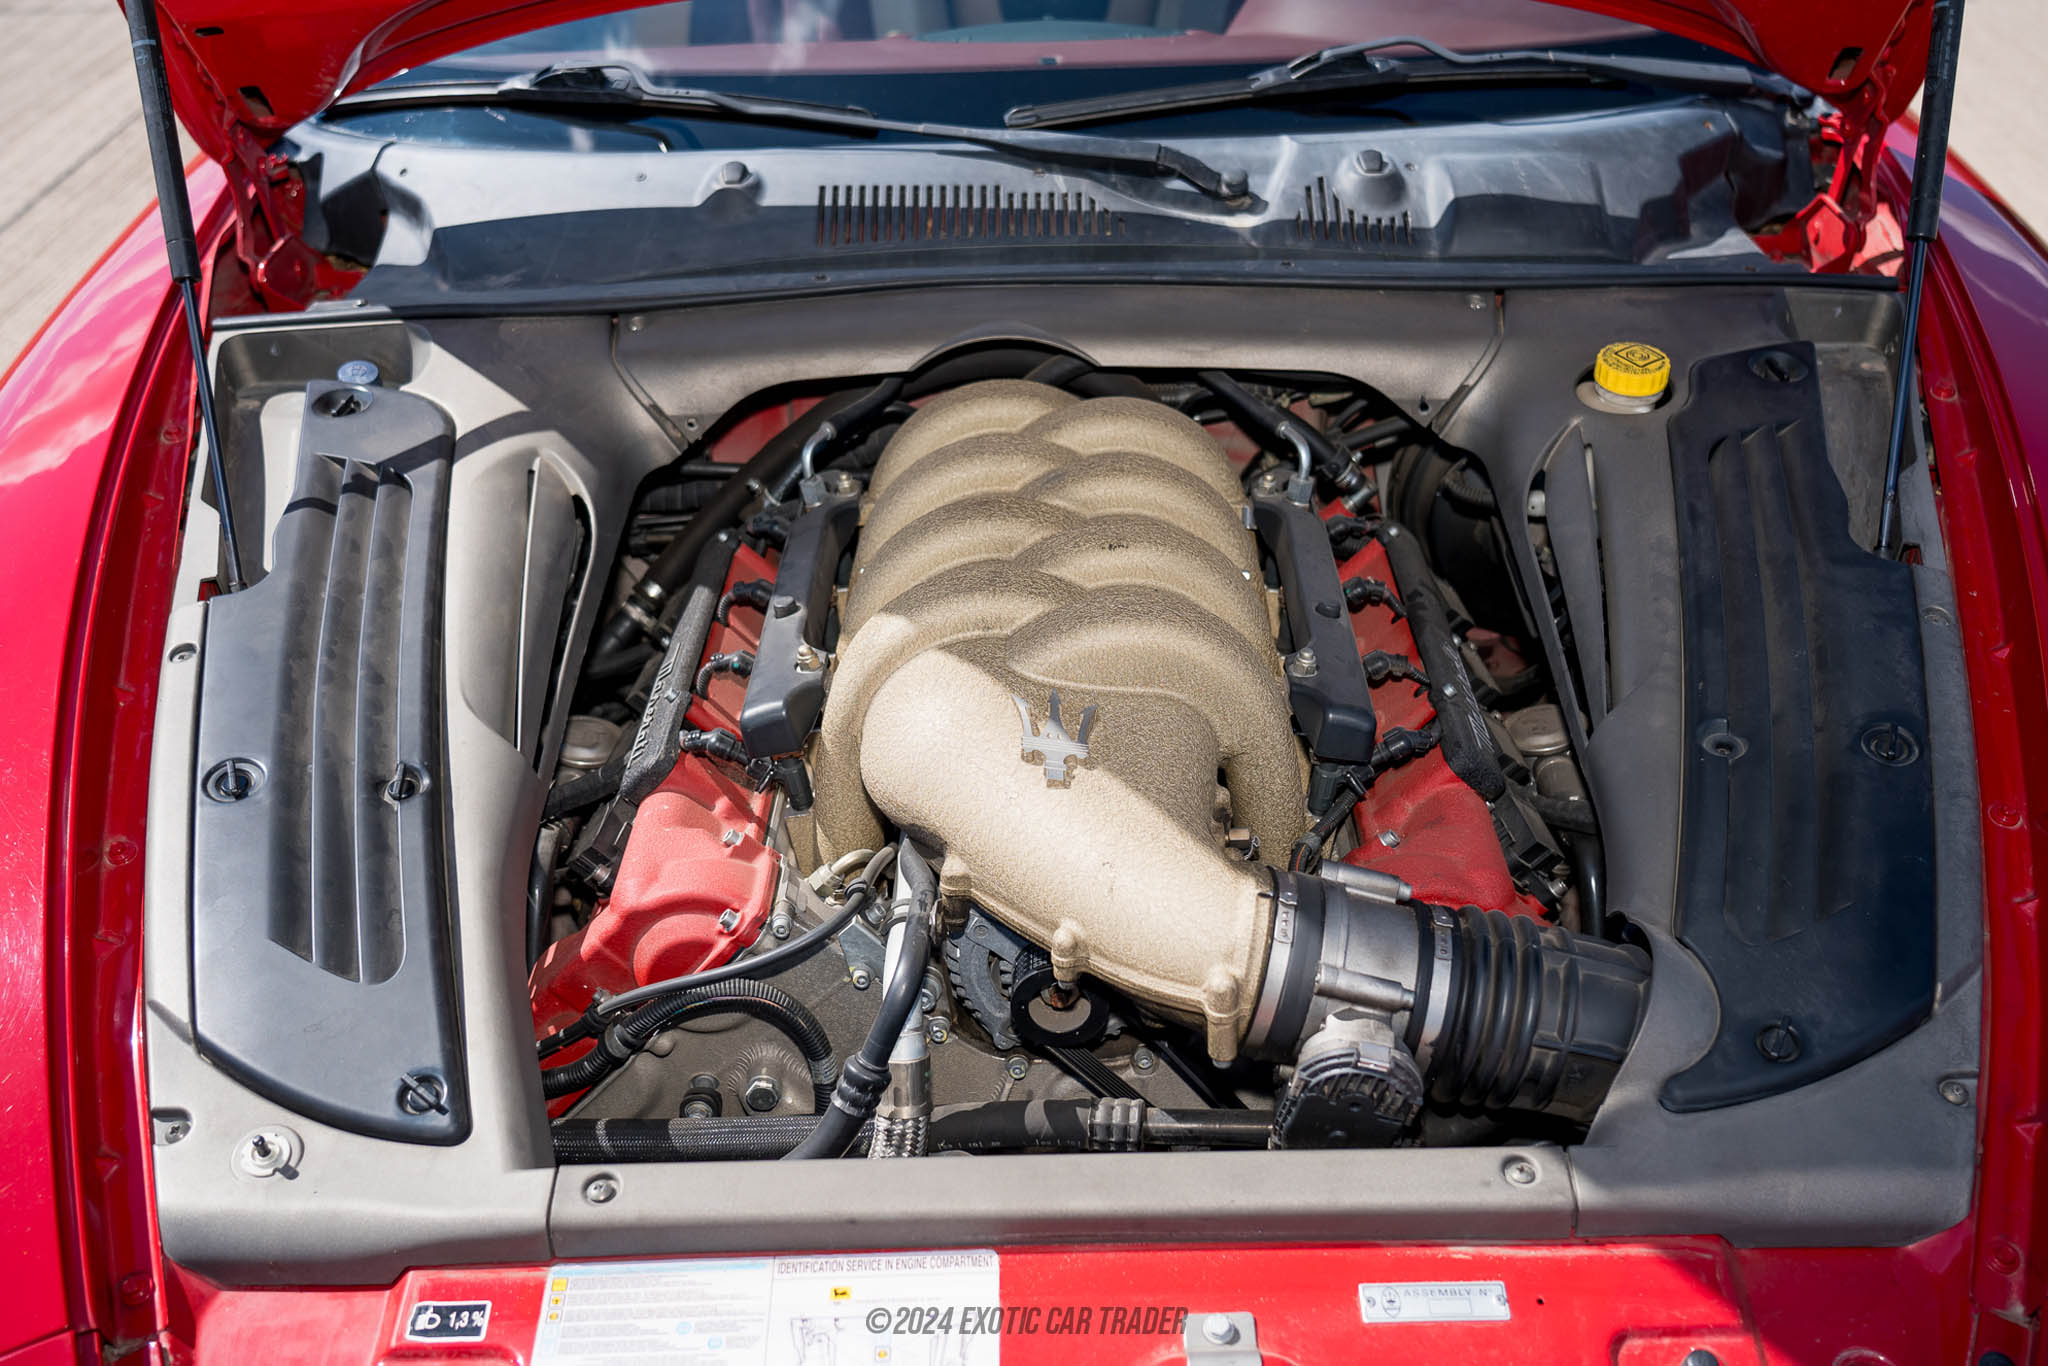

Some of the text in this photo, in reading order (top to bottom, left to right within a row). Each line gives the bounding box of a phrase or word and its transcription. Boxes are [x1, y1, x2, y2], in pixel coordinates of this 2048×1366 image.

[777, 1254, 993, 1275] IDENTIFICATION SERVICE IN ENGINE COMPARTMENT
[1404, 1287, 1472, 1297] ASSEMBLY
